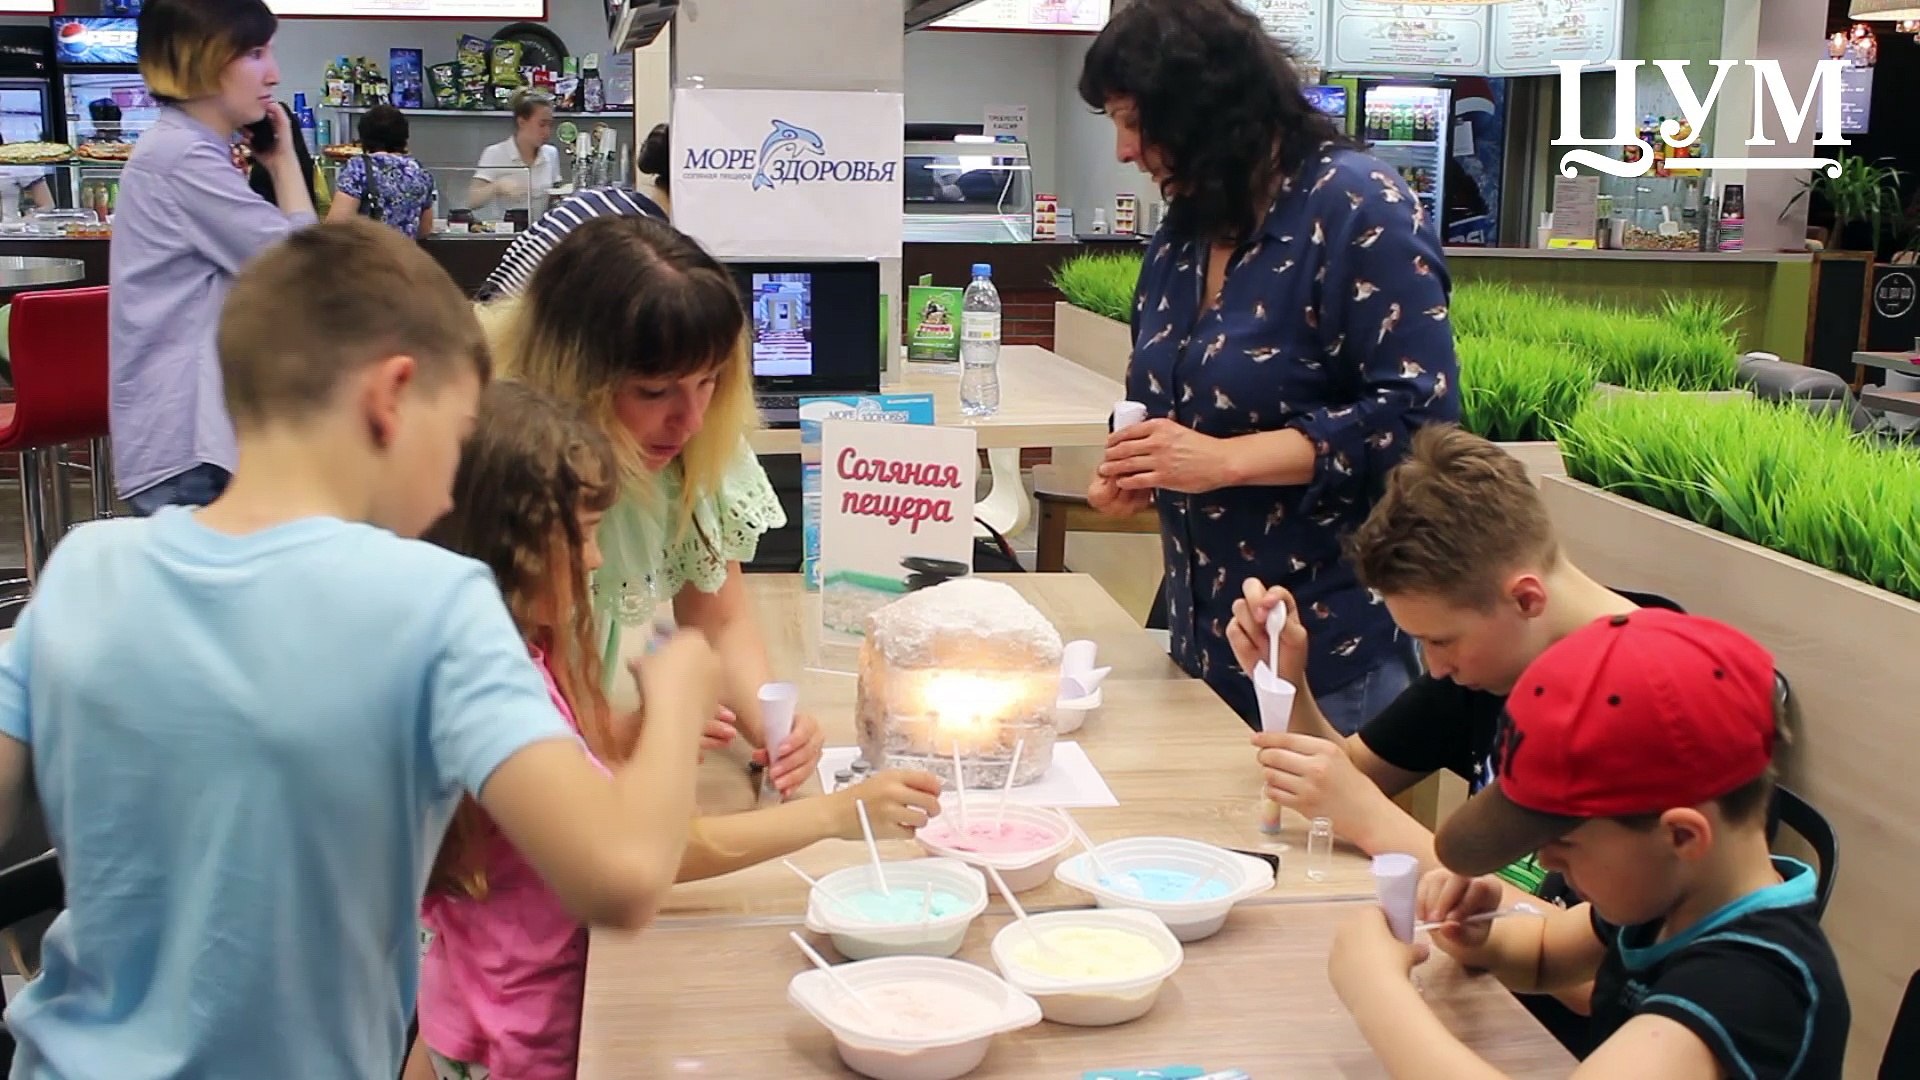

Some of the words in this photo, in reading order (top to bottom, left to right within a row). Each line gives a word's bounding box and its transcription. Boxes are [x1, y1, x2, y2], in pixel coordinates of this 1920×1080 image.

[88, 30, 138, 47] PEP
[684, 148, 757, 170] МОРЕ
[770, 160, 897, 185] ЗДОРОВЬЯ
[836, 447, 963, 489] Соляная
[840, 490, 954, 534] пещера
